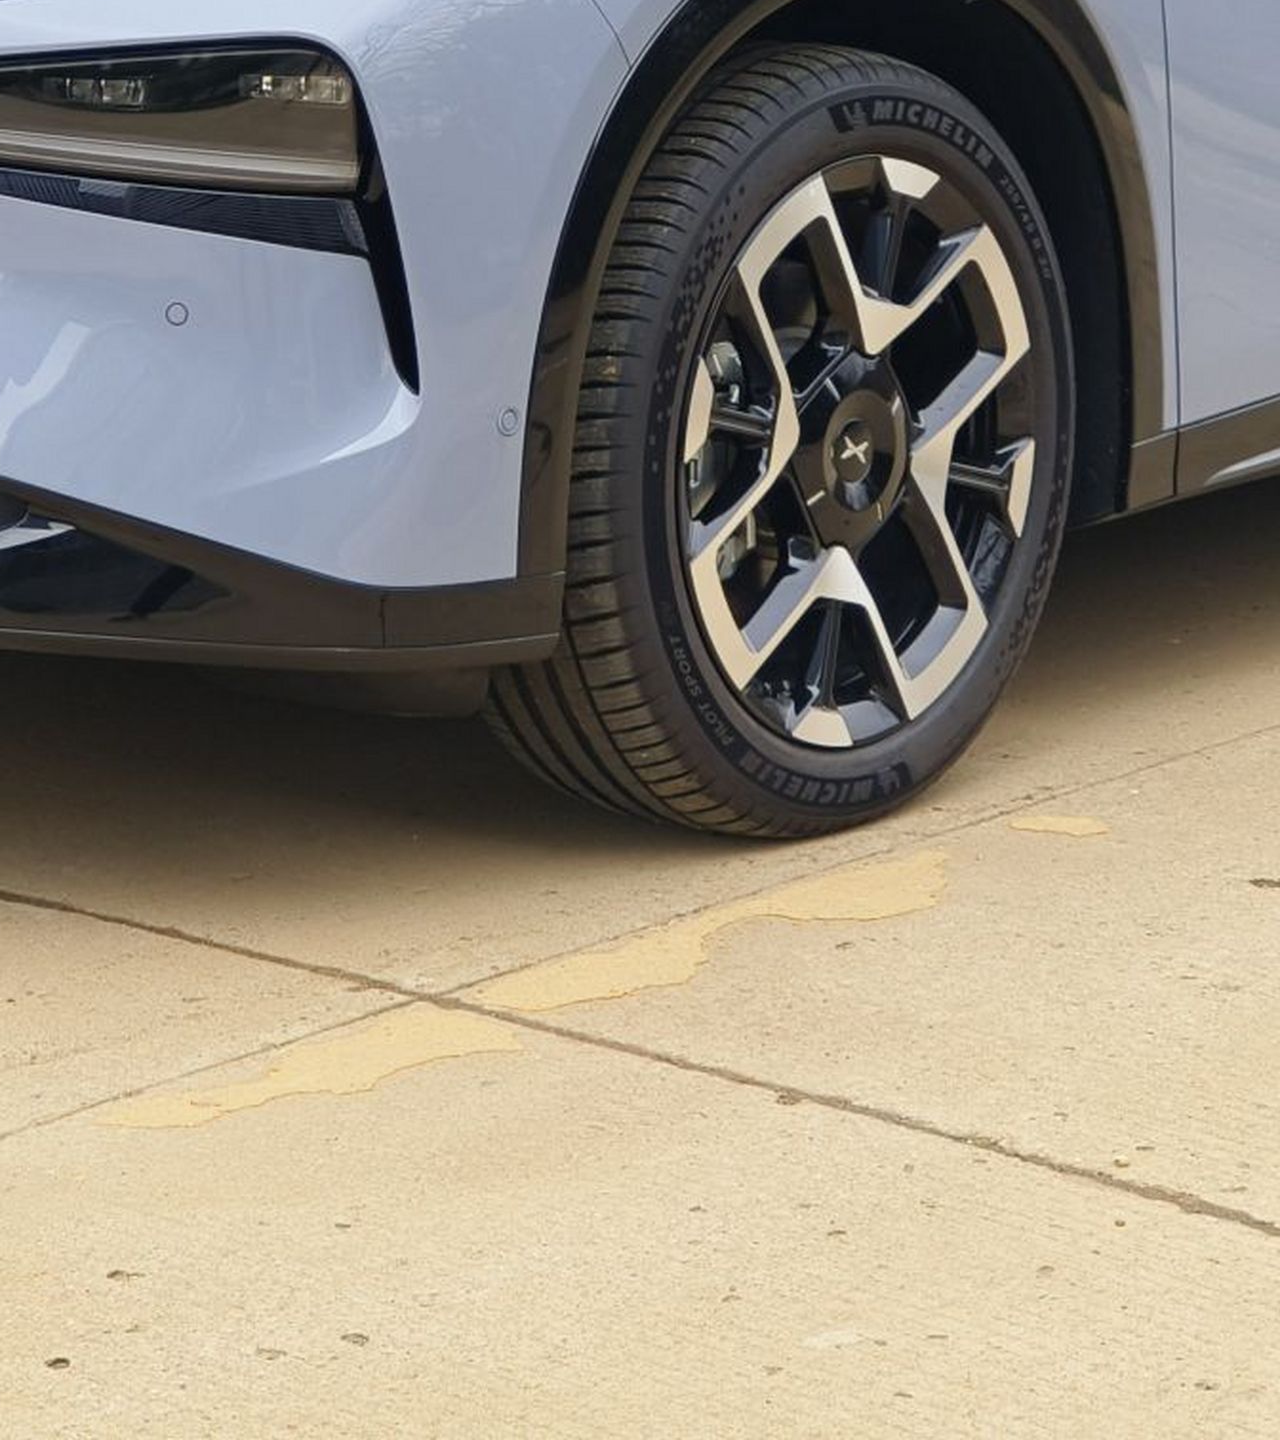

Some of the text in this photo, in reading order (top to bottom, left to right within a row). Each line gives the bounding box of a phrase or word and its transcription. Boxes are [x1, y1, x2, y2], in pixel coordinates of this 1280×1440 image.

[872, 99, 995, 169] MICHELIN
[668, 634, 874, 804] MICHELIN PILOT SPORT
